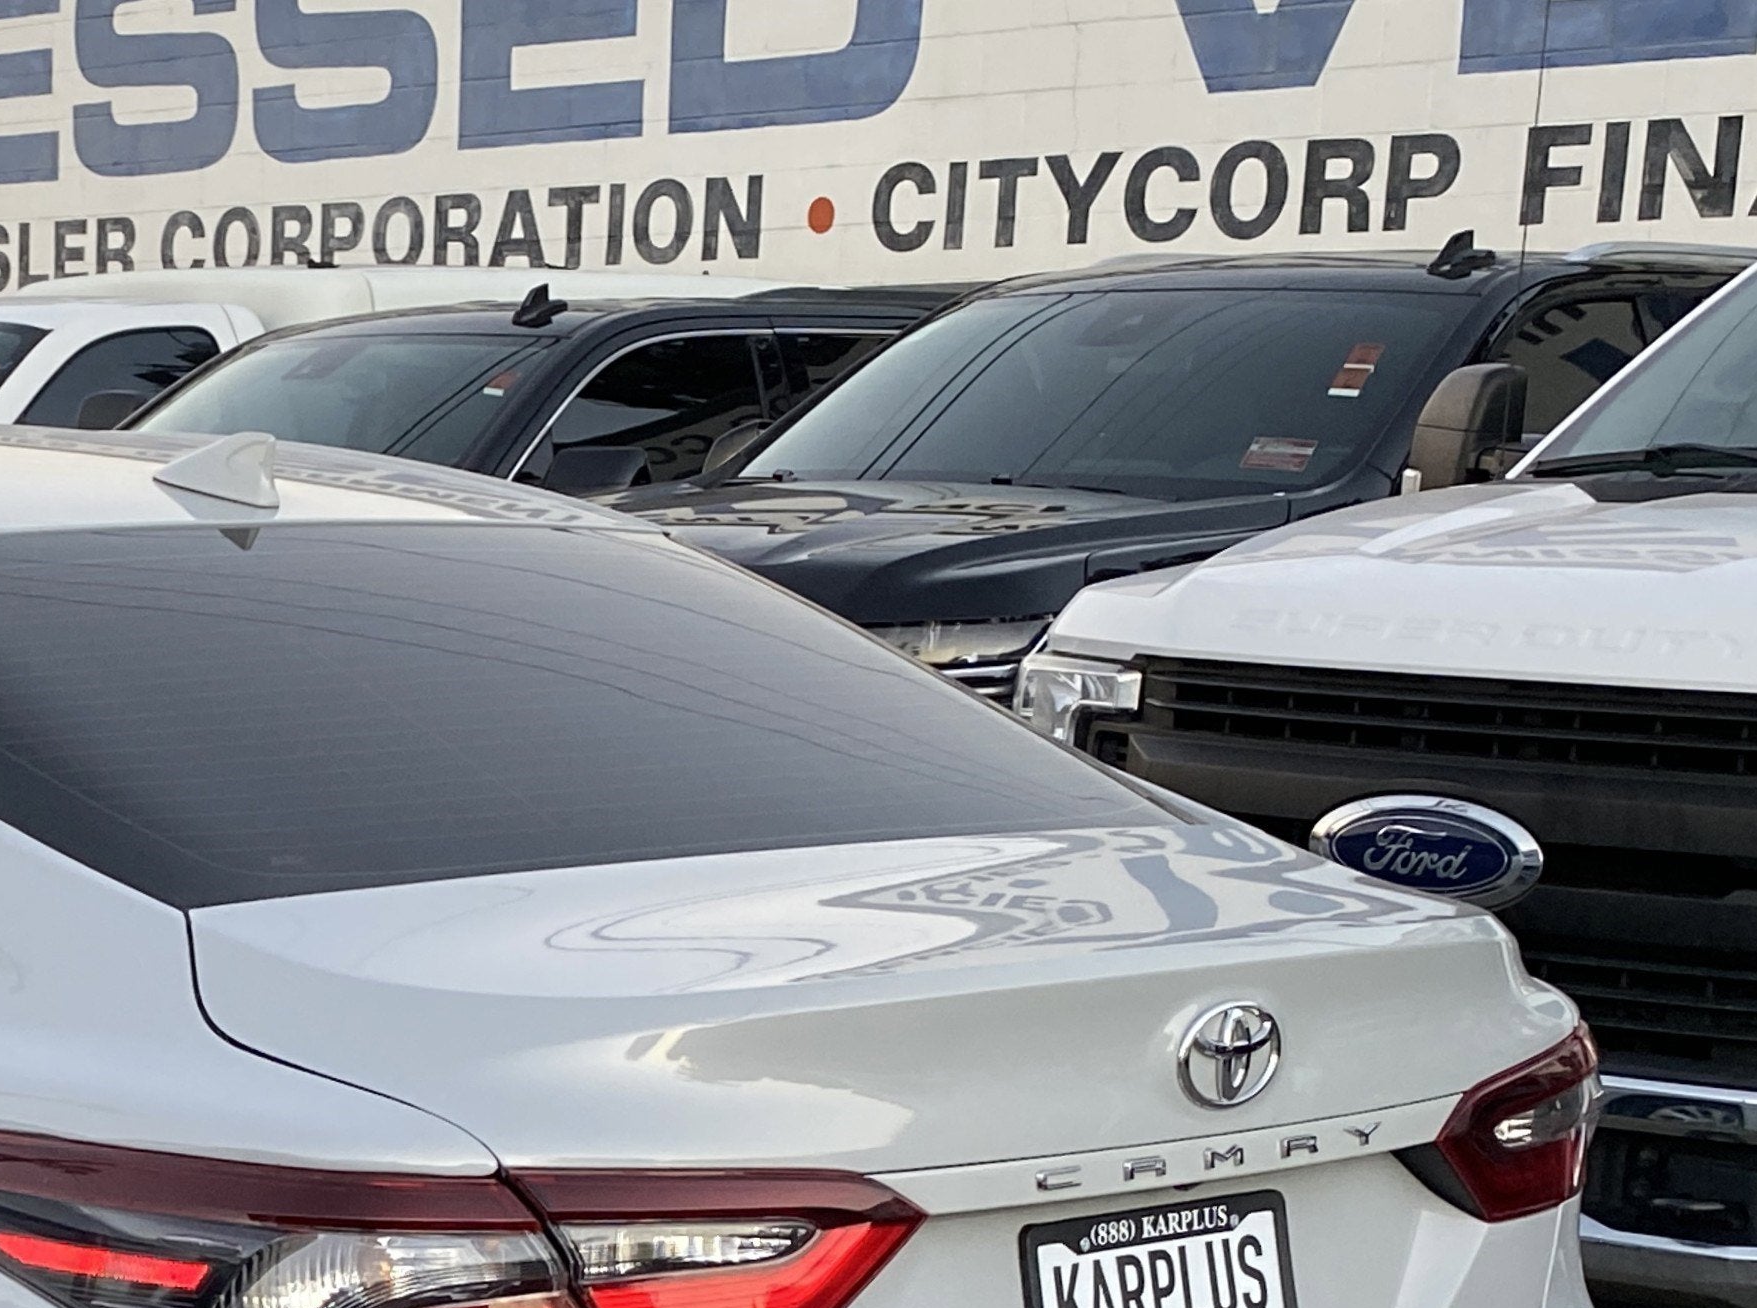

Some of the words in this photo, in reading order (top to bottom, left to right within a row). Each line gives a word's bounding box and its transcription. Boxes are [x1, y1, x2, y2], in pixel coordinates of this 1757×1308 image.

[161, 174, 764, 271] CORPORATION
[872, 132, 1462, 252] CITYCORP
[1519, 115, 1757, 225] FIN
[1363, 824, 1473, 880] Ford
[1035, 1120, 1382, 1192] CAMRY
[1090, 1218, 1136, 1247] (888)
[1141, 1204, 1228, 1239] KARPLUS
